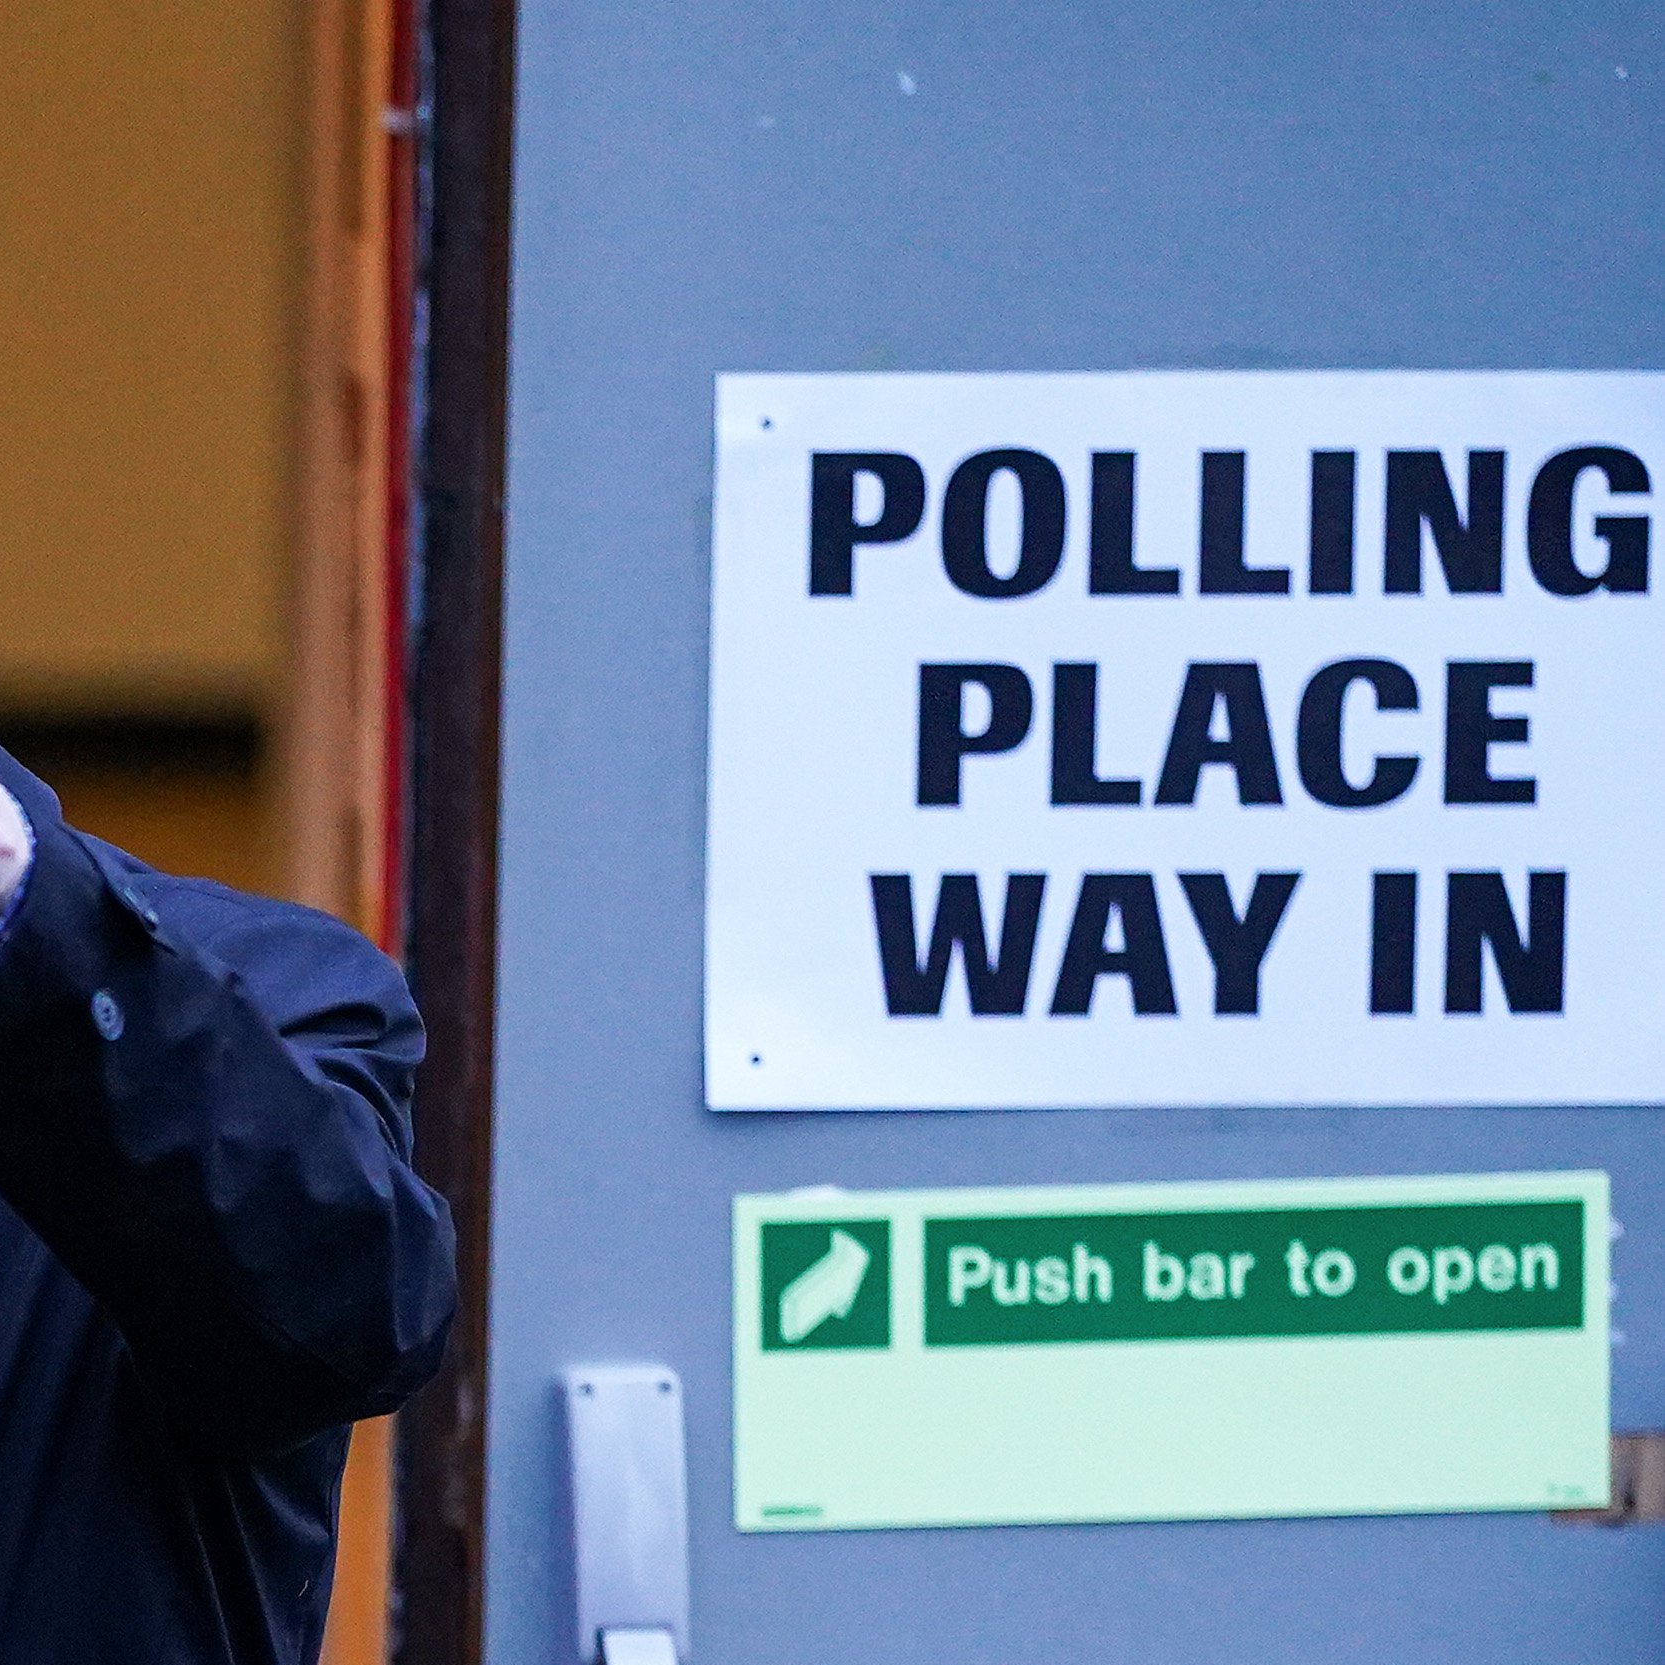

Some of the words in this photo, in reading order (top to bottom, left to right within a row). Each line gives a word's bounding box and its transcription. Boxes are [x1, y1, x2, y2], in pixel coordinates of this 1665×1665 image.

[807, 444, 1653, 600] POLLING
[915, 657, 1538, 810] PLACE
[868, 871, 1303, 1019] WAY
[1368, 869, 1568, 1017] IN
[948, 1243, 1113, 1306] Push
[1142, 1240, 1255, 1302] bar
[1286, 1240, 1357, 1297] to
[1386, 1242, 1560, 1304] open
